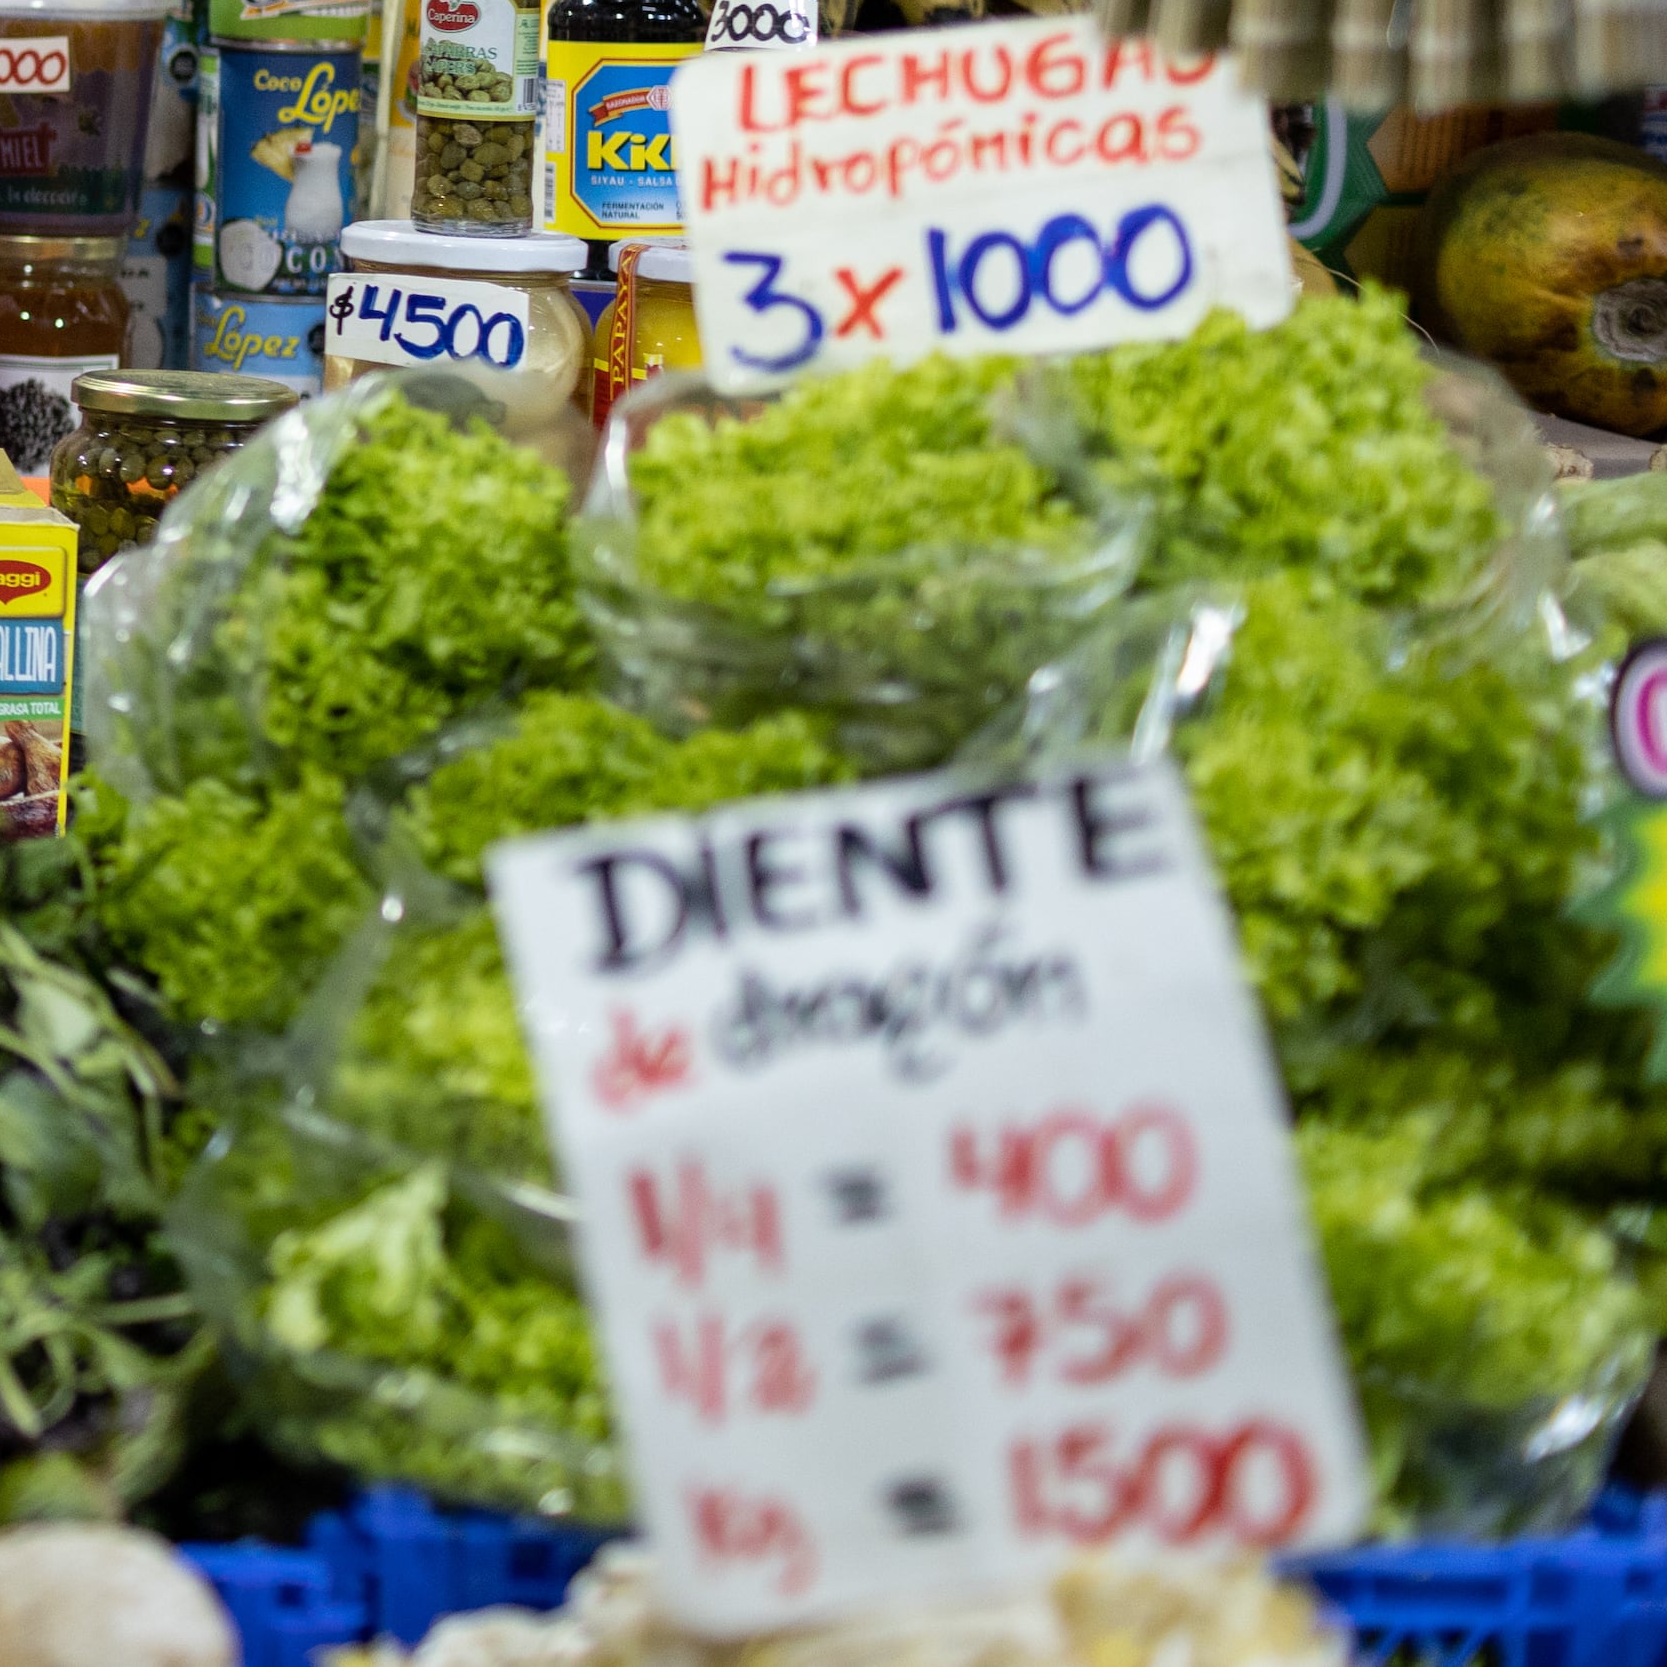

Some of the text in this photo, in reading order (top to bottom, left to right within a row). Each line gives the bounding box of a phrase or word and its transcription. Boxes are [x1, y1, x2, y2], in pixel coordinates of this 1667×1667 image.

[427, 7, 477, 25] Caperina
[253, 69, 302, 91] Coco
[0, 135, 43, 169] MIEL
[586, 130, 677, 172] KiK
[637, 176, 672, 187] SALSA
[601, 210, 640, 220] NATURAL
[613, 254, 634, 383] PAPAYA
[721, 249, 826, 372] 3
[925, 202, 1194, 334] 1000
[328, 284, 527, 370] $4500
[30, 701, 61, 715] TOTAL
[573, 768, 1182, 976] DIENTE
[946, 1100, 1202, 1229] 400
[971, 1269, 1232, 1390] 750
[1005, 1413, 1324, 1549] 1500
